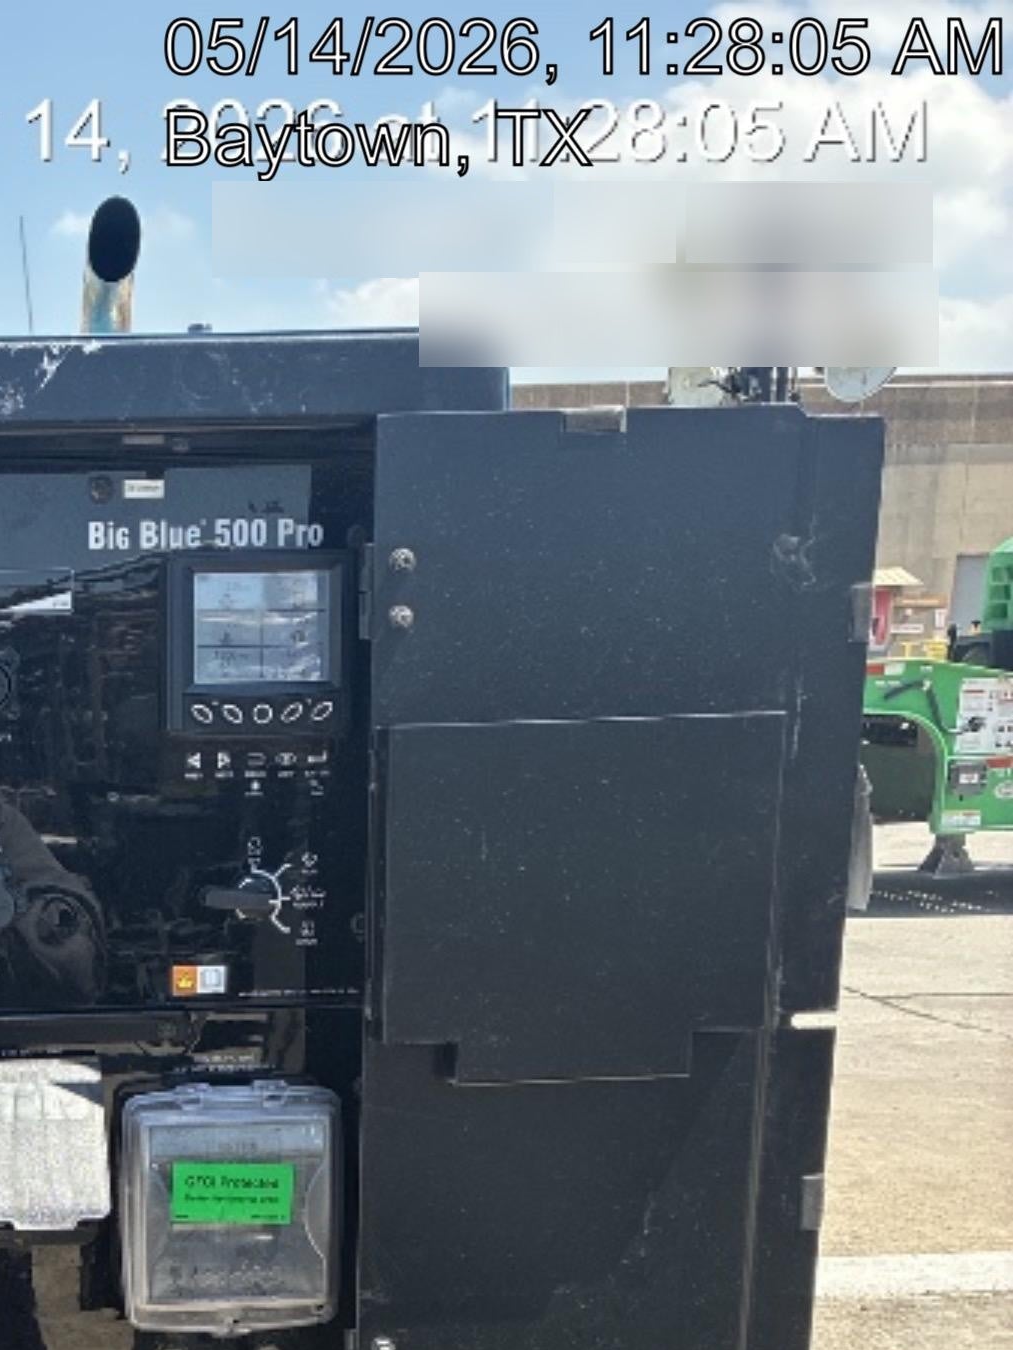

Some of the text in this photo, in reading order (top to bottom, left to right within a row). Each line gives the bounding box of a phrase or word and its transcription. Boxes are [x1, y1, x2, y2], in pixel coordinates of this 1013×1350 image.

[139, 519, 202, 549] Blue
[214, 518, 269, 548] 500
[276, 518, 326, 548] Pro
